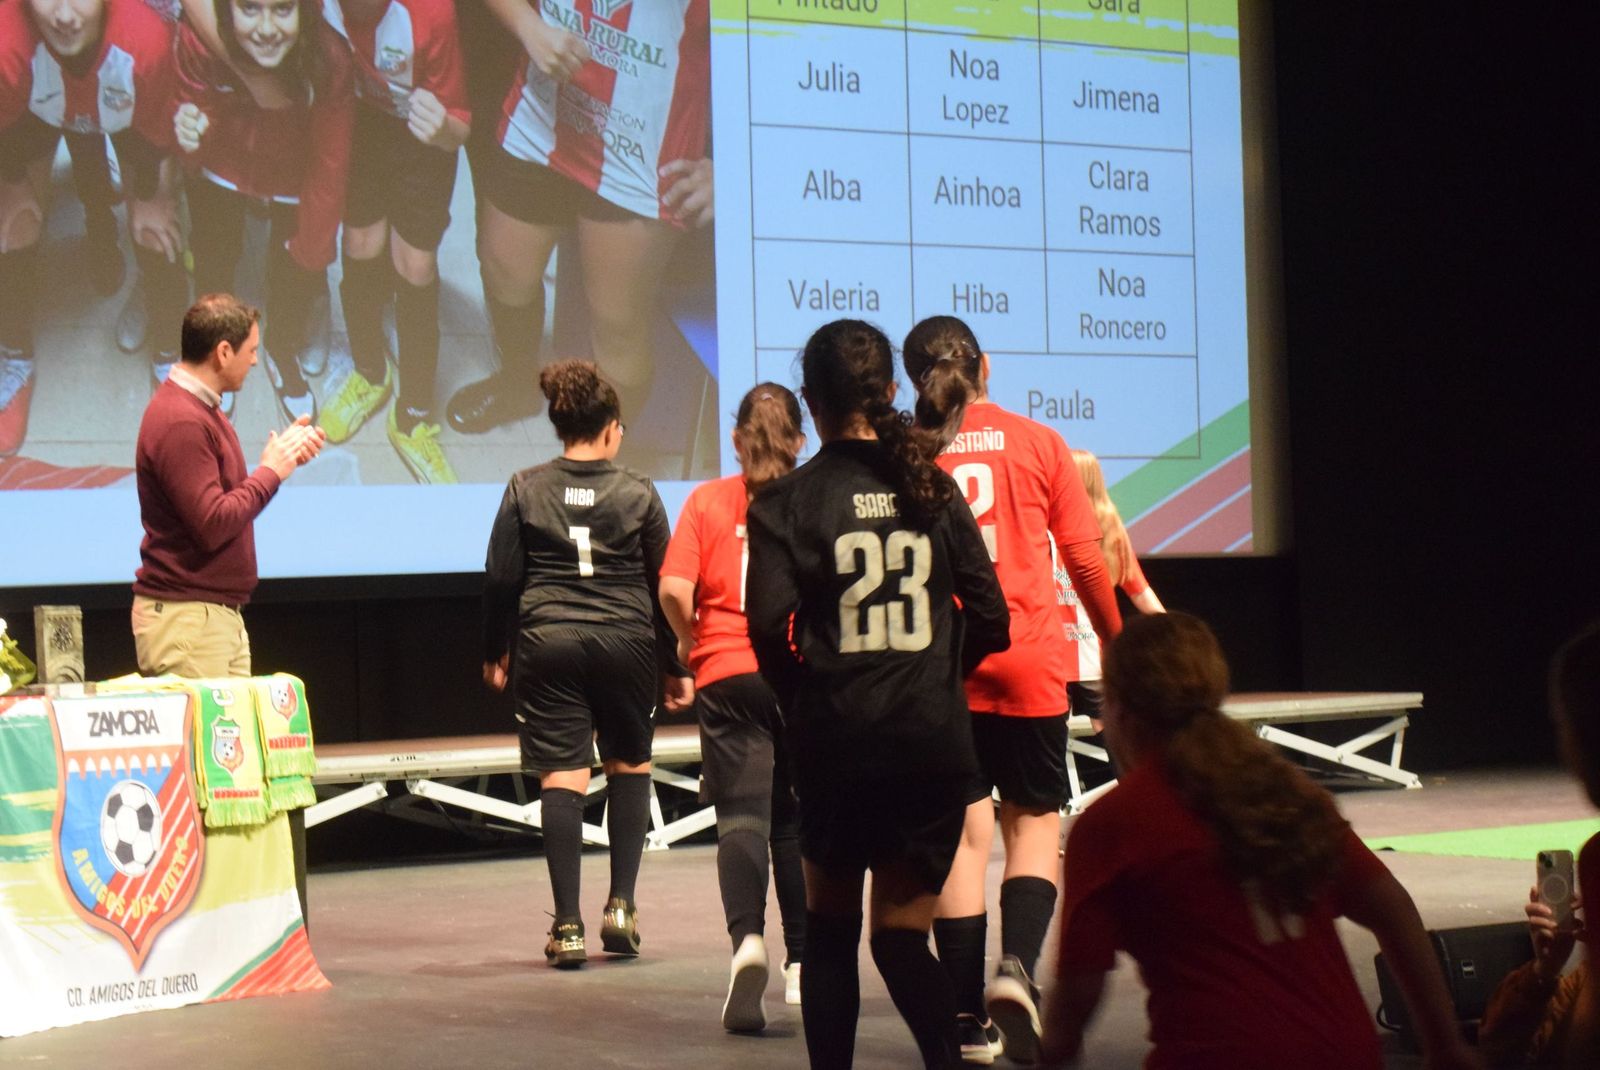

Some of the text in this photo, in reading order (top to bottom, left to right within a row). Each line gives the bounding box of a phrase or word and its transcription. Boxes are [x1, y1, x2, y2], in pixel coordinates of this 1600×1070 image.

[590, 21, 667, 69] RURAL
[799, 61, 860, 94] Julia
[950, 49, 1000, 81] Noa
[943, 95, 1009, 128] Lopez
[1073, 81, 1160, 114] Jimena
[803, 170, 861, 201] Alba
[934, 176, 1021, 208] Ainhoa
[1088, 160, 1149, 192] Clara
[1079, 206, 1161, 237] Ramos
[788, 279, 880, 311] Valeria
[952, 283, 1009, 314] Hiba
[1099, 268, 1146, 298] Noa
[1080, 313, 1166, 341] Roncero
[1028, 389, 1095, 420] Paula
[564, 487, 595, 507] HIBA
[569, 526, 593, 577] 1
[834, 530, 932, 653] 23
[87, 709, 160, 738] ZAMORA
[72, 848, 126, 917] AMIGOS
[89, 982, 135, 1005] AMIGOS
[138, 979, 157, 999] DEL
[162, 973, 199, 996] DUERO
